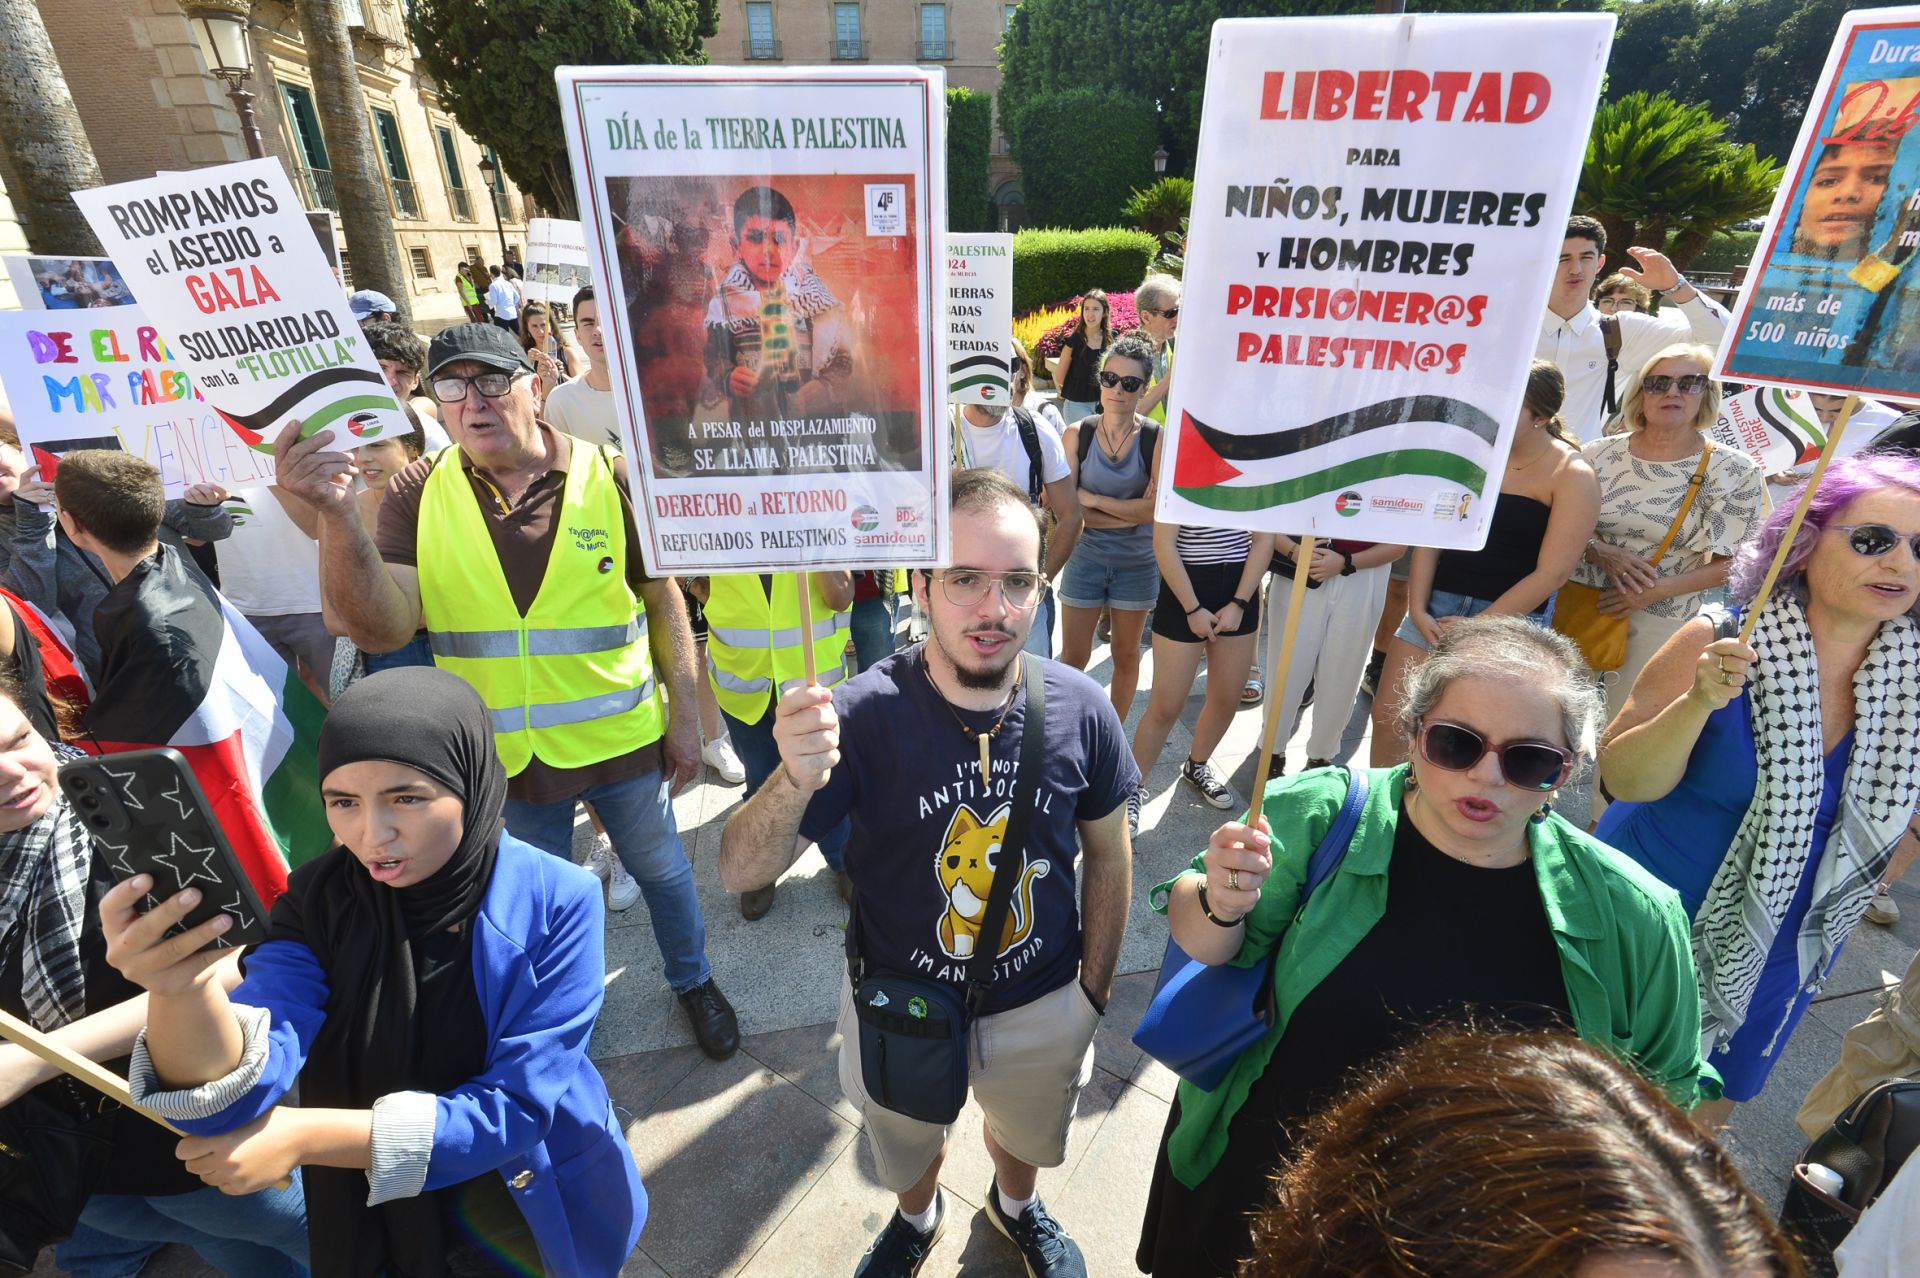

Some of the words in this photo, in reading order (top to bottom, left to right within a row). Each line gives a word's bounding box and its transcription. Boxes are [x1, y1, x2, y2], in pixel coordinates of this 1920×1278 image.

[1259, 69, 1552, 124] LIBERTAD
[606, 111, 649, 151] DÍA
[653, 118, 678, 150] de
[684, 118, 703, 150] la
[705, 117, 787, 150] TIERRA
[791, 117, 907, 149] PALESTINA
[1345, 148, 1401, 167] PARA
[107, 178, 279, 240] ROMPAMOS
[1224, 177, 1349, 227] NIÑOS,
[1360, 187, 1547, 228] MUJERES
[145, 254, 169, 275] el
[168, 226, 261, 272] ASEDIO
[268, 234, 284, 254] a
[1257, 251, 1271, 268] Y
[1278, 237, 1475, 277] HOMBRES
[184, 264, 282, 315] GAZA
[1226, 284, 1489, 327] PRISIONER@S
[1765, 291, 1806, 314] más
[1816, 293, 1842, 316] de
[949, 305, 982, 317] ADAS
[26, 329, 79, 365] DE
[90, 328, 130, 363] EL
[178, 309, 340, 362] SOLIDARIDAD
[1746, 320, 1786, 344] 500
[1794, 323, 1850, 350] niños
[1235, 331, 1467, 375] PALESTIN@S
[42, 372, 117, 414] MAR
[200, 372, 224, 391] con
[224, 363, 240, 386] la
[688, 423, 697, 439] A
[702, 421, 742, 439] PESAR
[748, 421, 765, 438] del
[771, 416, 877, 437] DESPLAZAMIENTO
[1728, 399, 1756, 449] PALESTINA
[1748, 417, 1771, 449] LIBRE
[693, 449, 715, 471] SE
[723, 446, 780, 470] LLAMA
[789, 444, 876, 468] PALESTINA
[655, 492, 742, 518] DERECHO
[747, 501, 757, 516] al
[760, 488, 848, 516] RETORNO
[1372, 498, 1423, 509] samidoun
[661, 531, 753, 552] REFUGIADOS
[761, 528, 847, 549] PALESTINOS
[854, 531, 925, 544] samidoun
[993, 759, 1020, 774] NOT
[910, 947, 934, 972] I'M
